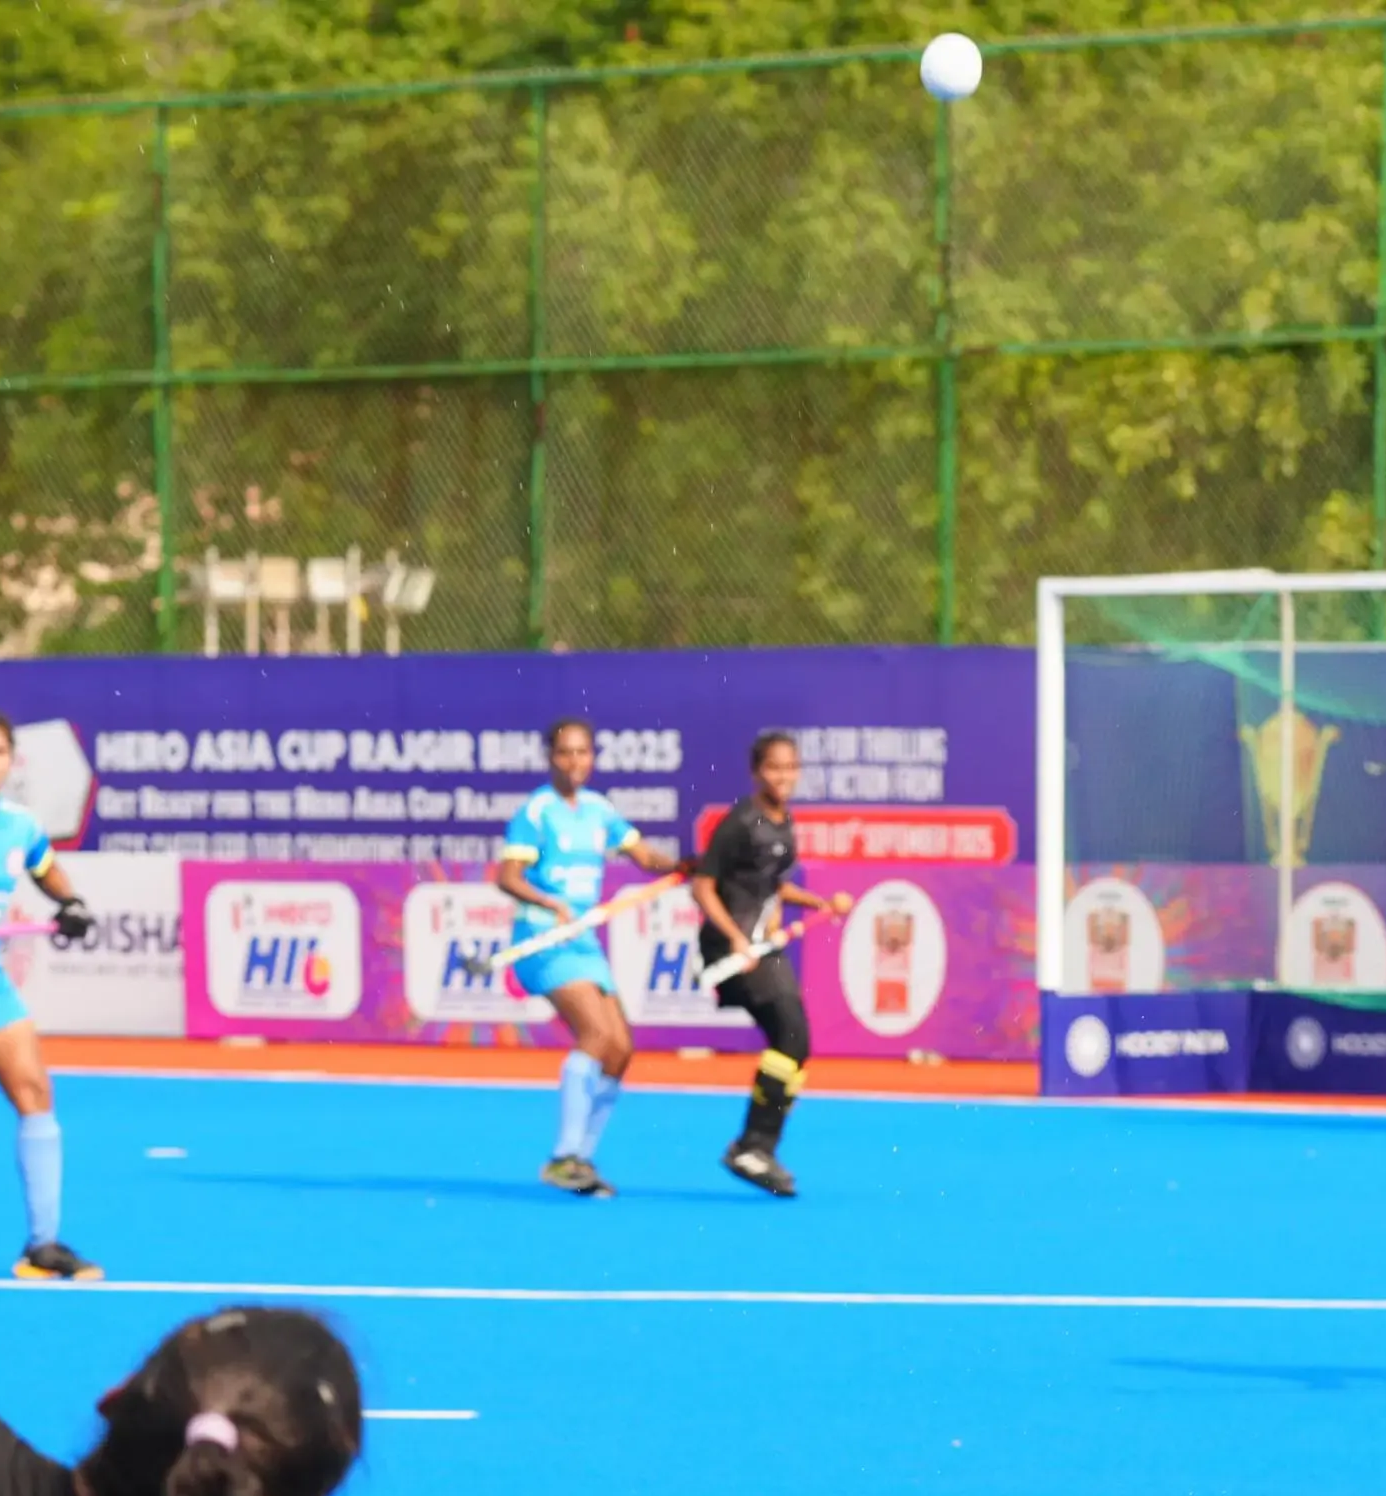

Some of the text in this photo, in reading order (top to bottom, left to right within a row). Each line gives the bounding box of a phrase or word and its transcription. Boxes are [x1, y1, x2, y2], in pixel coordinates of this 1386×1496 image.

[191, 729, 276, 773] ASIA
[277, 729, 348, 773] CUP
[596, 729, 683, 773] 2025
